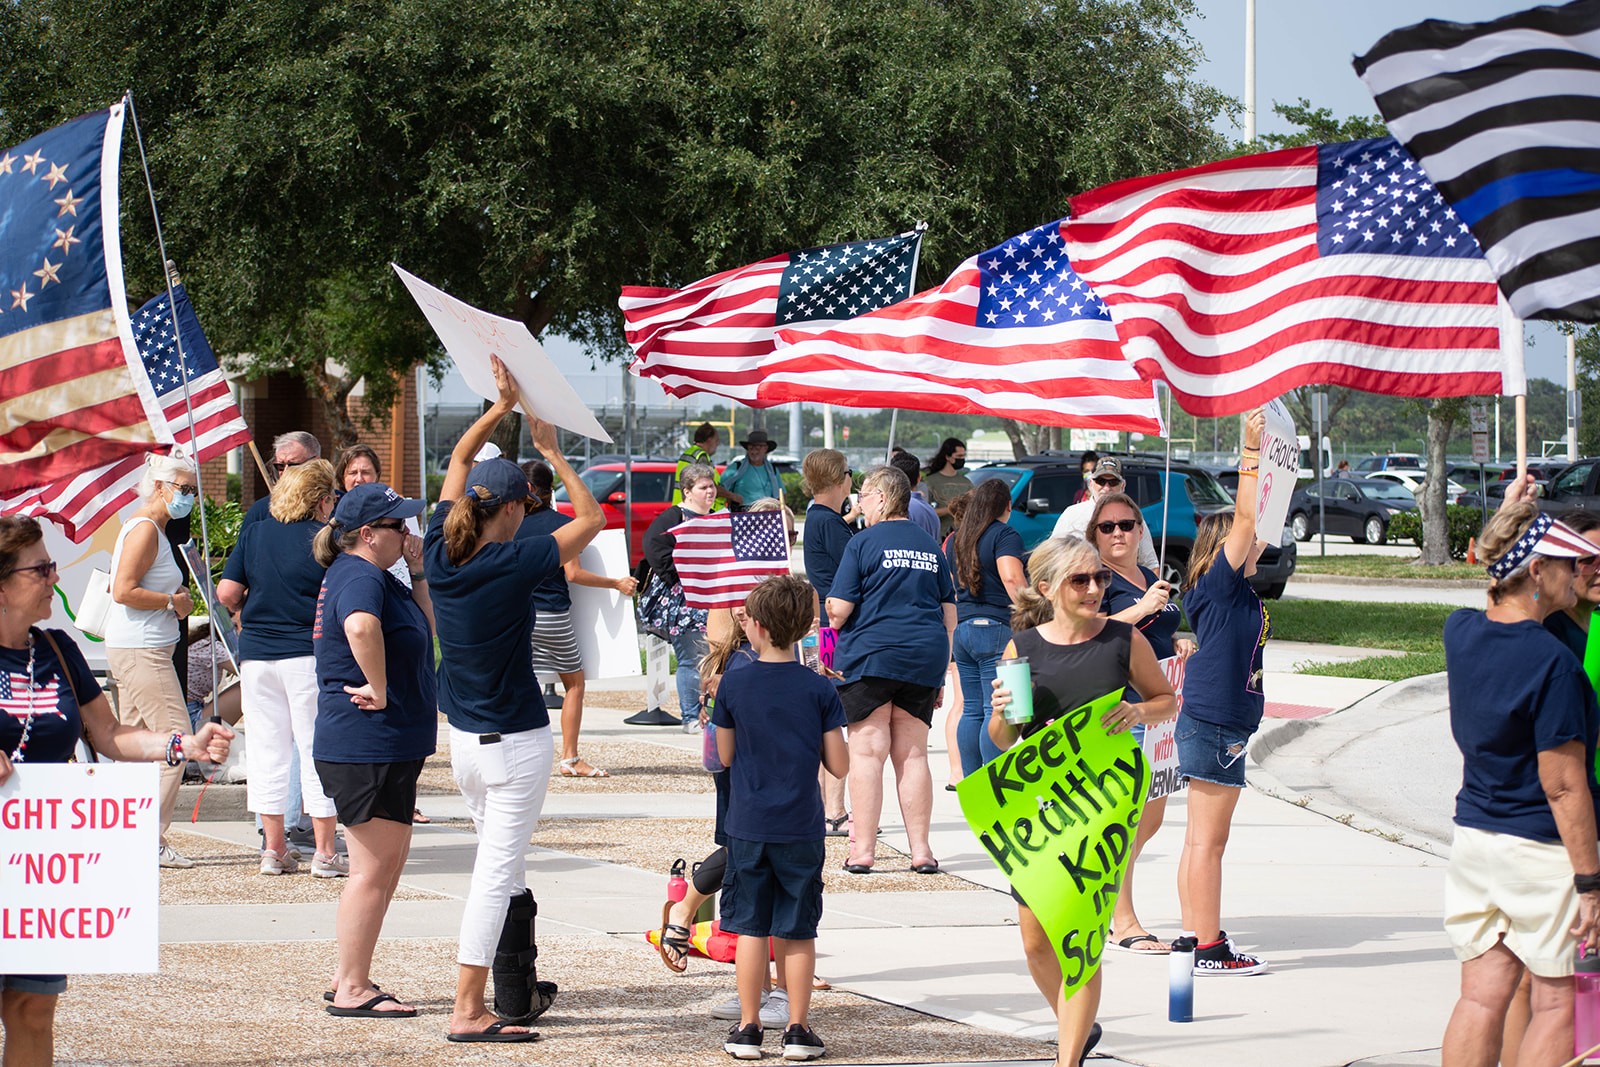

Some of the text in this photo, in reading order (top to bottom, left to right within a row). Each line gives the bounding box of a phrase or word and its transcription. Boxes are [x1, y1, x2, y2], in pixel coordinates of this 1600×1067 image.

[882, 559, 939, 573] OUR KIDS
[883, 549, 938, 563] UNMASK
[1153, 730, 1174, 763] with
[2, 798, 63, 830] GHT
[979, 746, 1145, 877] Healthy
[1197, 959, 1256, 969] CONVERSE
